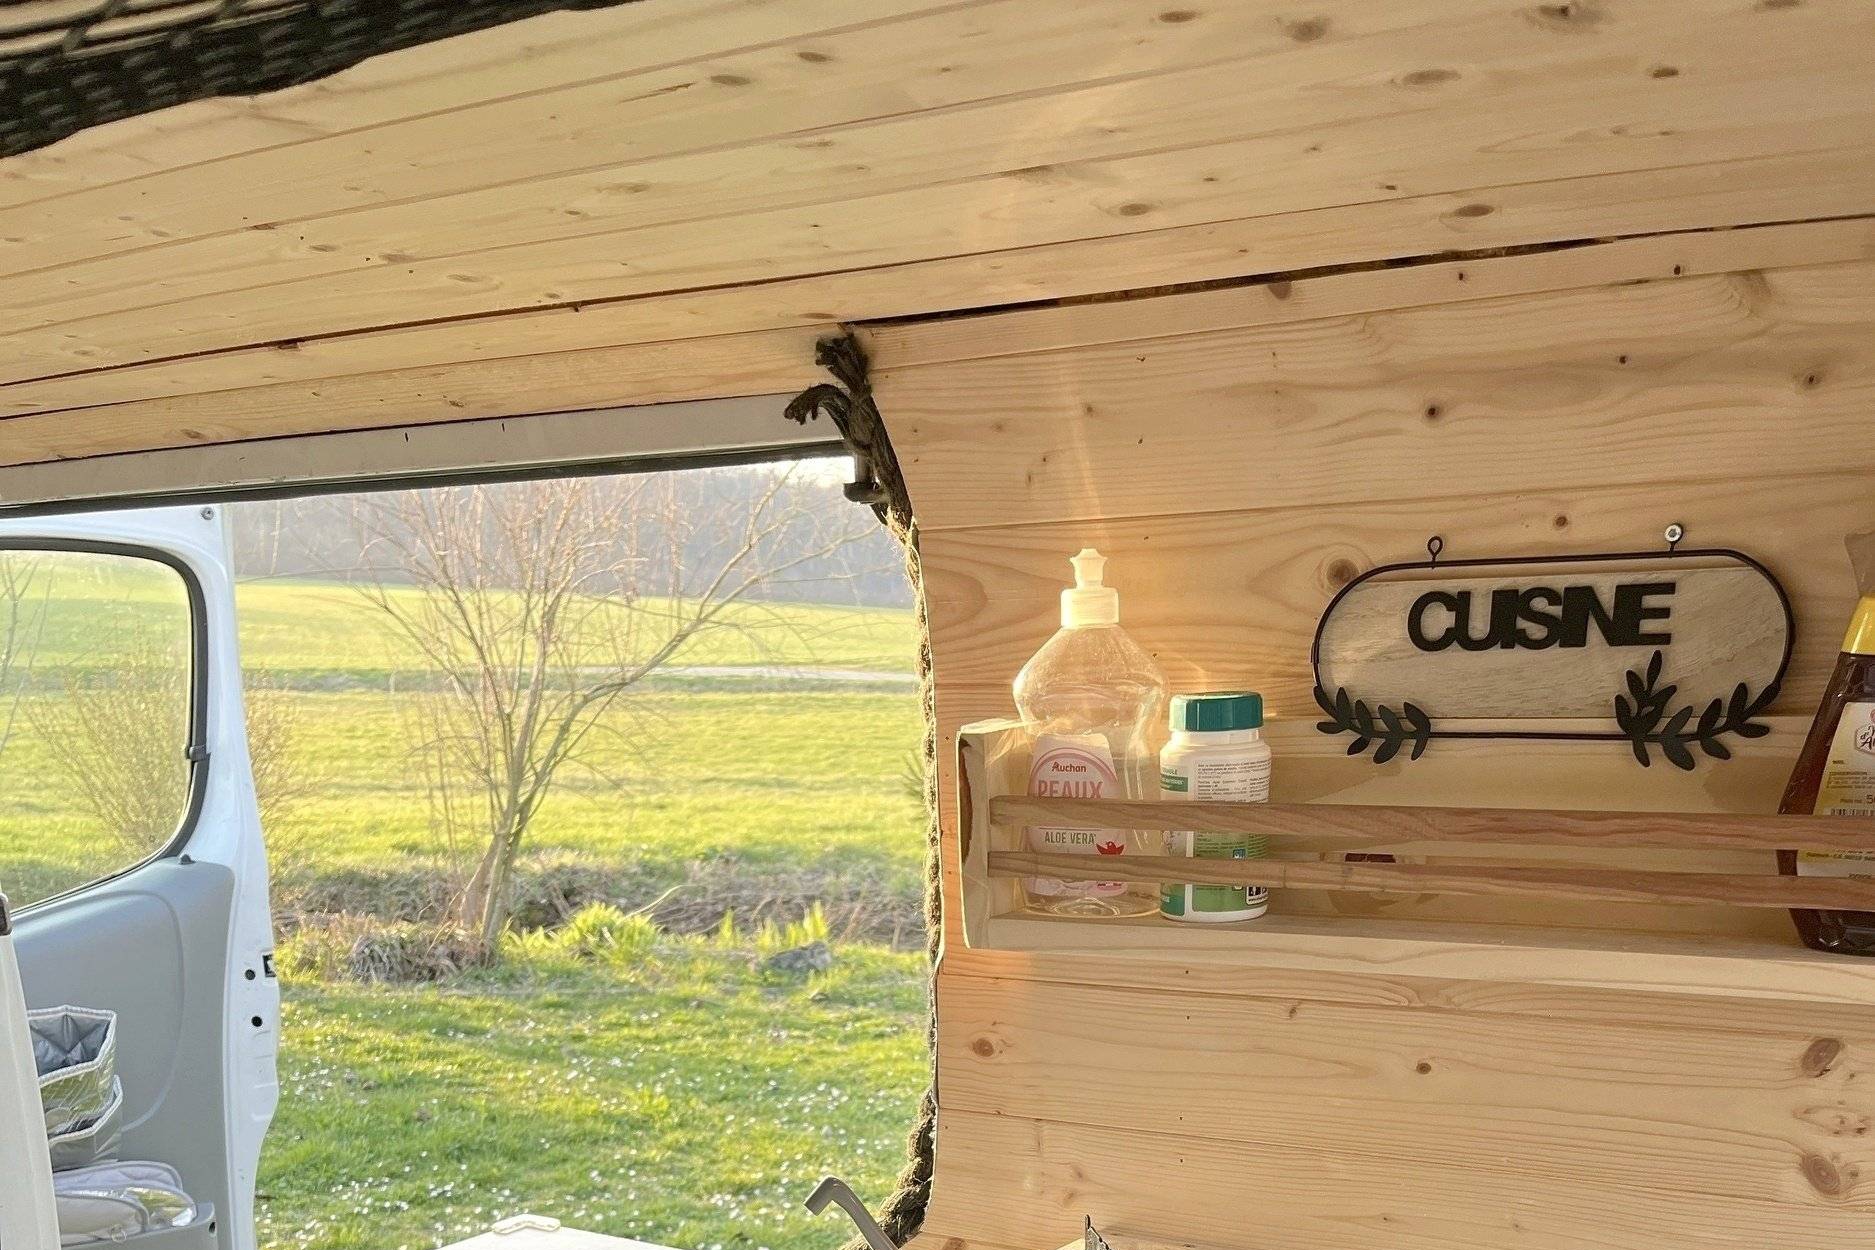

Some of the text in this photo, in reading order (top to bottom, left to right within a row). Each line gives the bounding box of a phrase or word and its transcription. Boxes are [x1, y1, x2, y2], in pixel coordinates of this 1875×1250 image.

[1407, 582, 1677, 652] CUISINE
[1051, 761, 1087, 773] Auchan
[1037, 779, 1104, 799] PEAUX
[1044, 831, 1067, 844] ALOE
